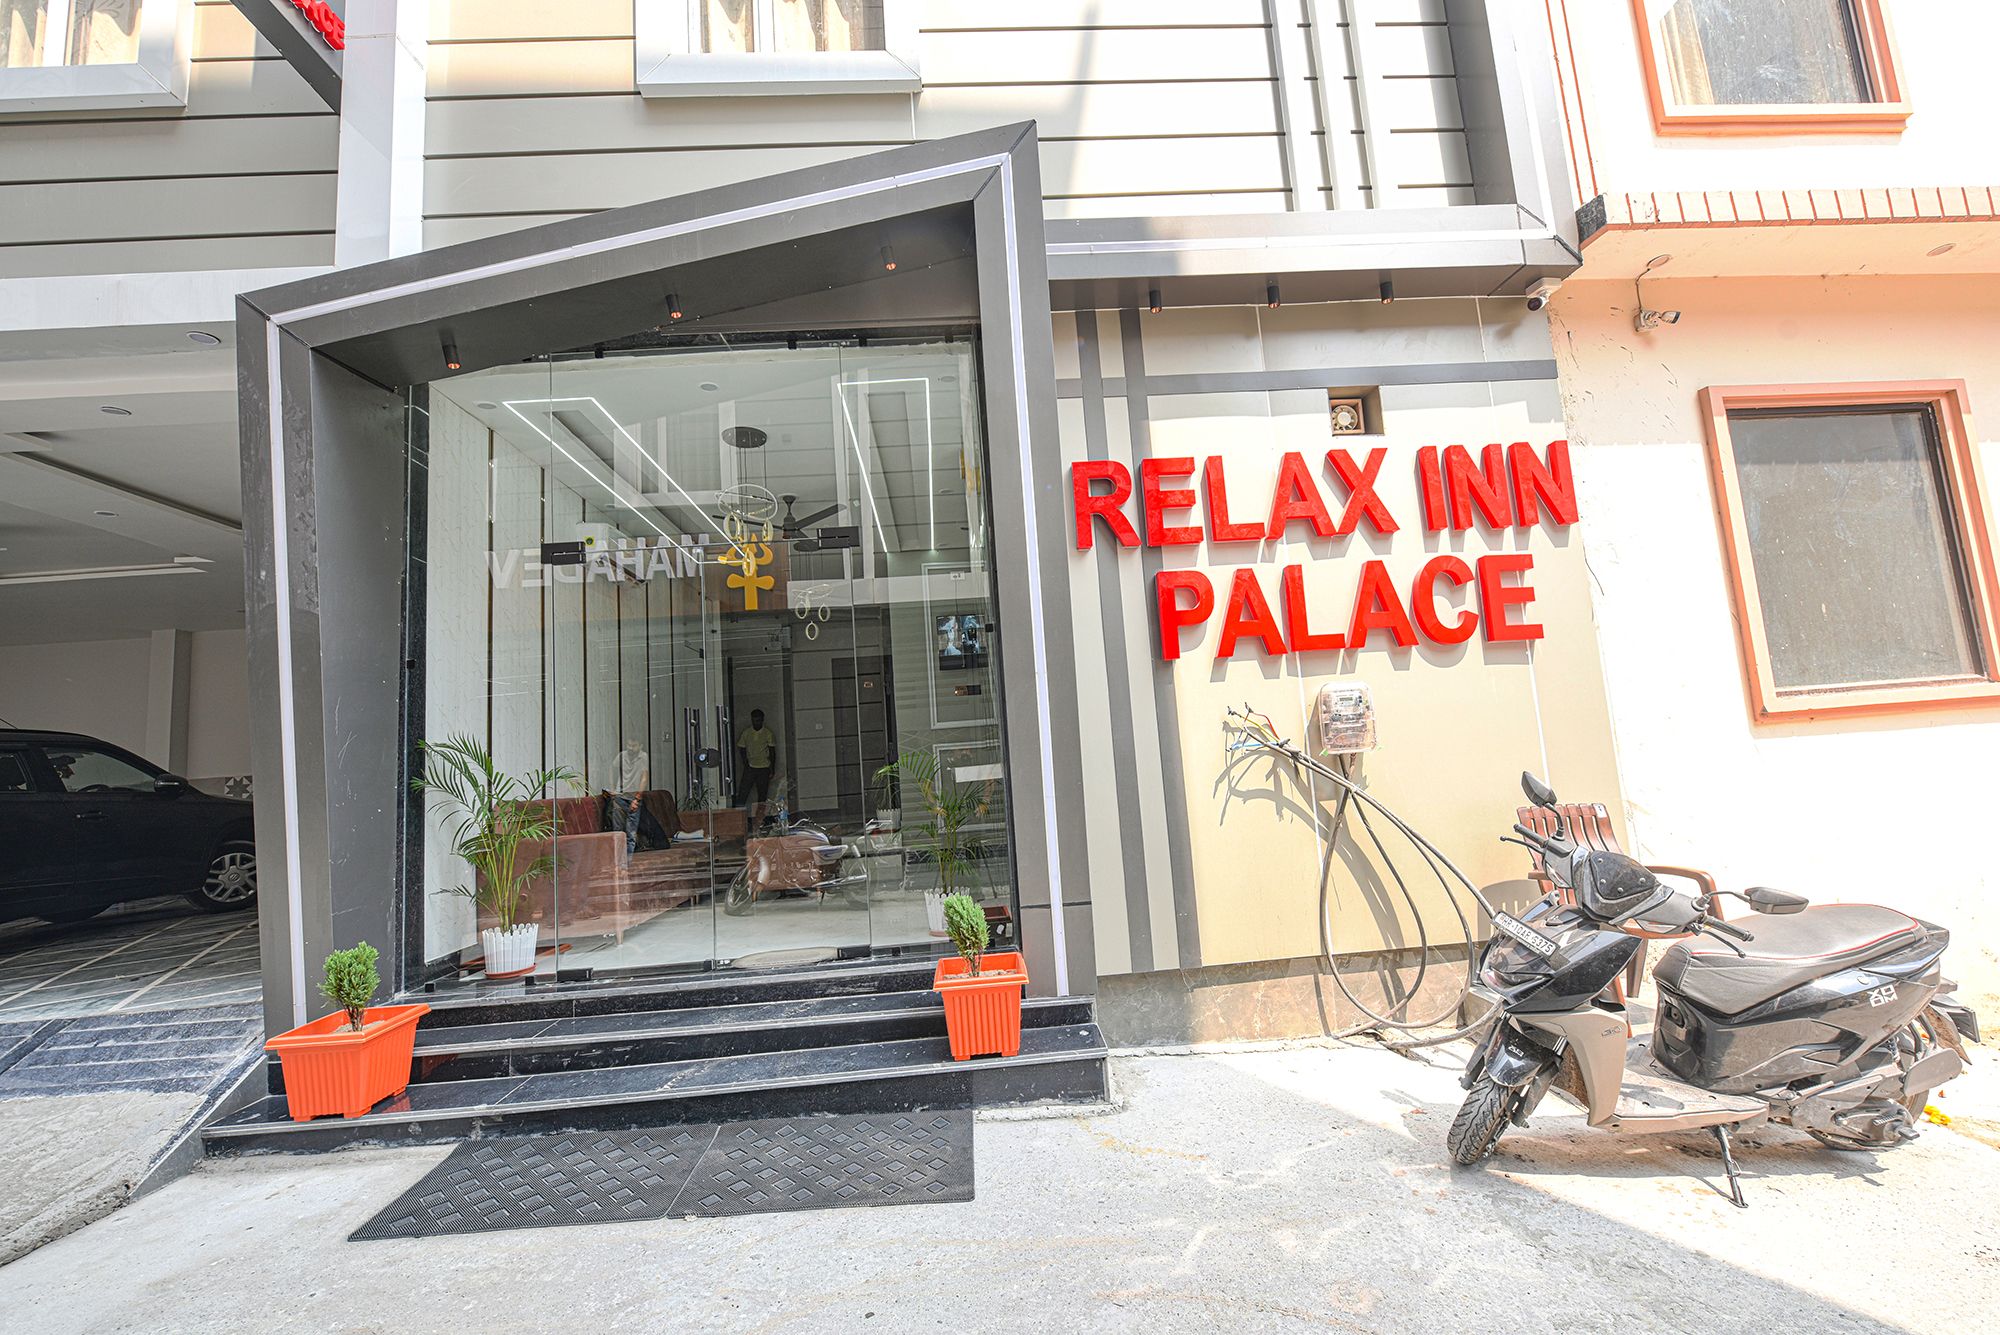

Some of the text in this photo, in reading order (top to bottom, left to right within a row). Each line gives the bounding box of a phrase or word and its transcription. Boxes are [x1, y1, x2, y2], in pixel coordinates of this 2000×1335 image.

[1071, 440, 1580, 550] RELAX INN
[1155, 554, 1546, 662] PALACE
